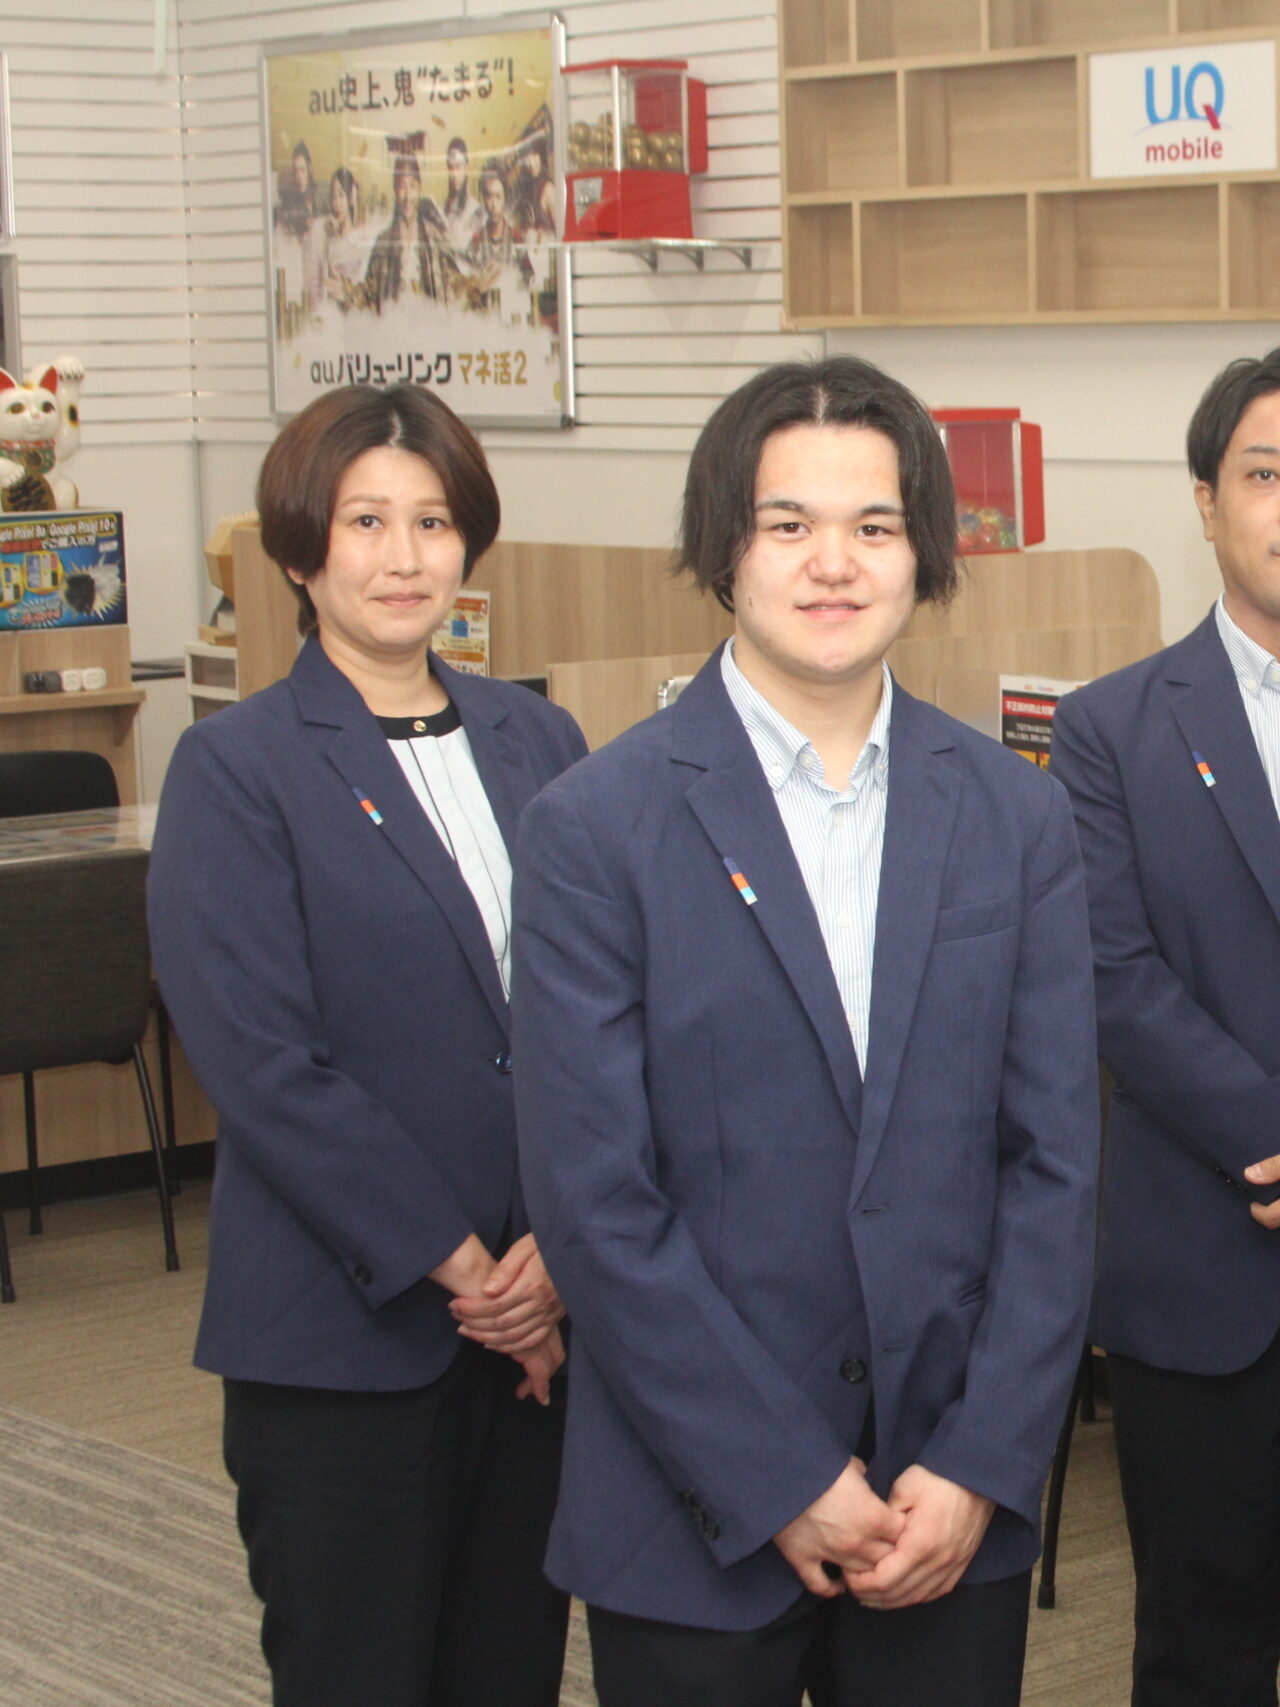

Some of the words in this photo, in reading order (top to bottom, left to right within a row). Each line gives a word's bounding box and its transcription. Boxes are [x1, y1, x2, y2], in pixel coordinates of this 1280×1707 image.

[1145, 61, 1225, 130] UQ
[1145, 137, 1224, 163] mobile
[310, 352, 453, 386] auバリューリンク
[457, 350, 528, 386] マネ活2
